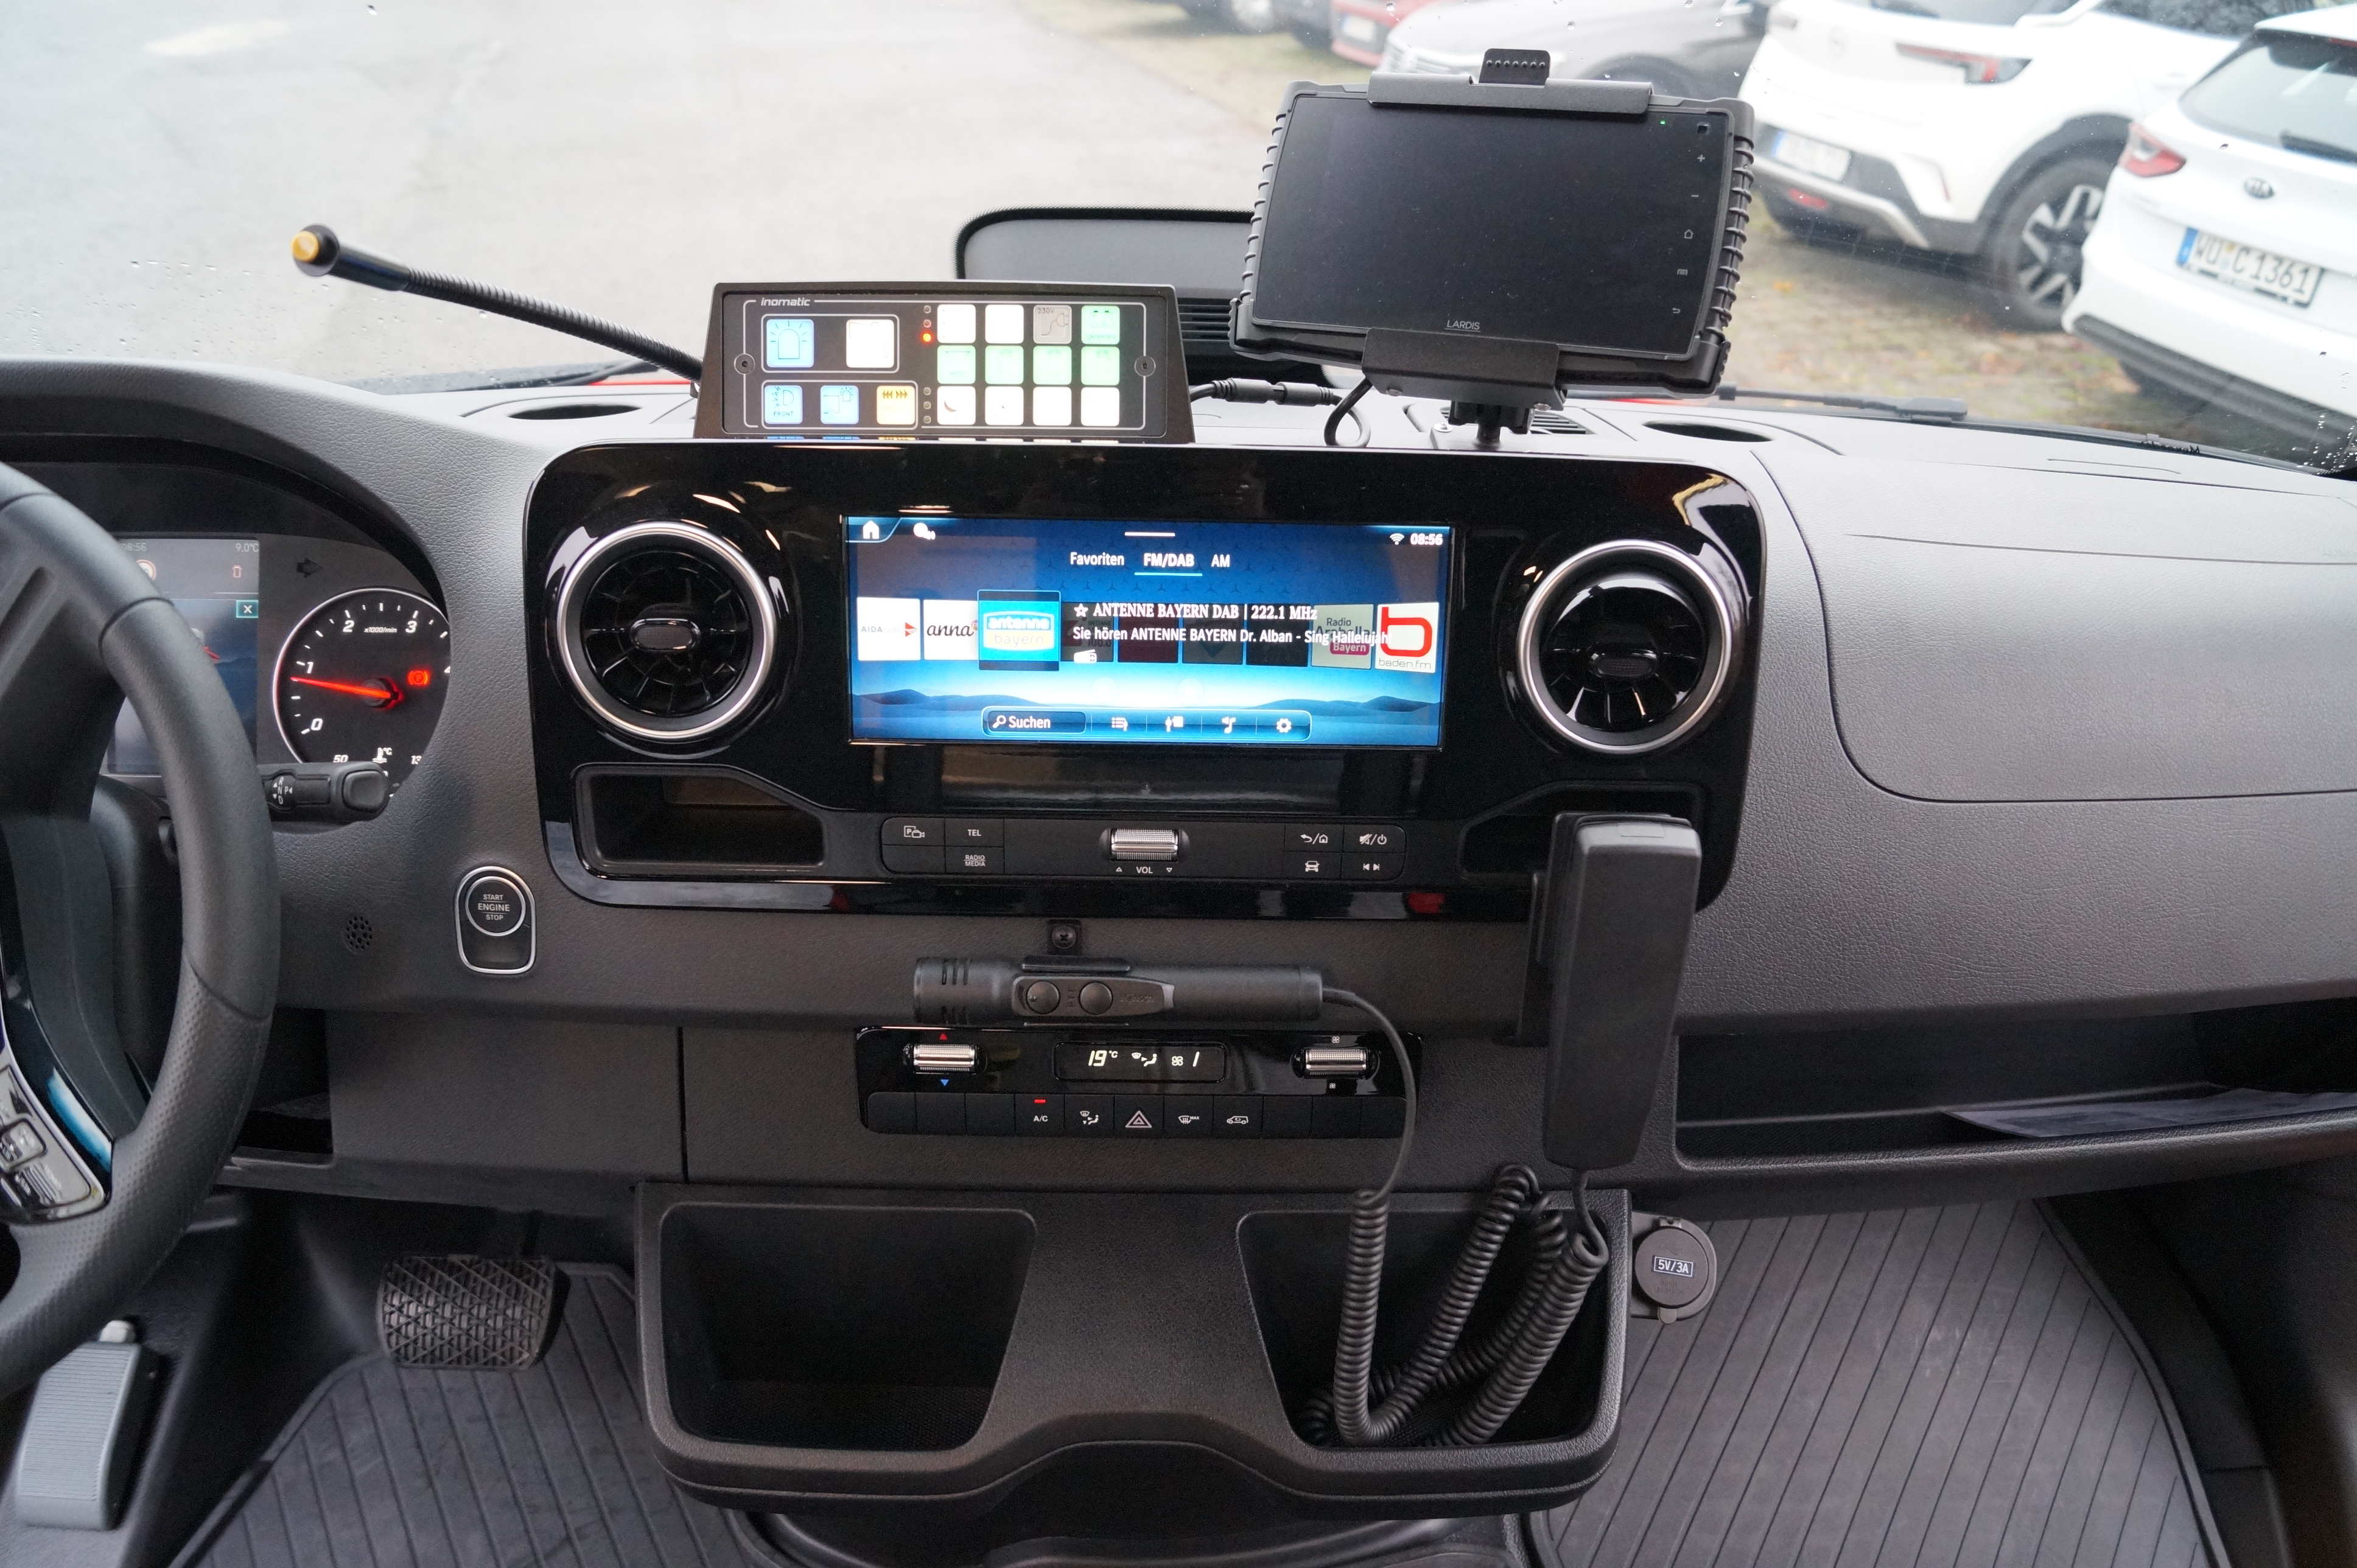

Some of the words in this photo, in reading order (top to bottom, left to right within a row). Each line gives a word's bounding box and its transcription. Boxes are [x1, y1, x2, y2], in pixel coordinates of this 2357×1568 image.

[761, 297, 811, 306] inomatic
[1446, 320, 1480, 330] LARDIS
[1410, 533, 1443, 545] 08:56
[1070, 551, 1125, 565] Favoriten
[1144, 553, 1194, 567] FM/DAB
[1211, 554, 1230, 567] AM
[1093, 603, 1154, 617] ANTENNE
[1158, 603, 1209, 618] BAYERN
[1213, 604, 1239, 618] DAB
[1251, 605, 1285, 619] 222.1
[1289, 606, 1317, 620] MHz
[343, 620, 354, 632] 2
[405, 621, 417, 633] 3
[988, 615, 1051, 630] antenne
[1326, 618, 1351, 627] Radio
[926, 624, 975, 637] anna
[1073, 626, 1091, 640] Sie
[1094, 626, 1127, 640] hören
[1131, 628, 1186, 641] ANTENNE
[1190, 628, 1236, 642] BAYERN
[1240, 629, 1256, 642] Dr.
[1259, 629, 1292, 643] Alban
[1304, 631, 1329, 646] Sing
[1332, 631, 1392, 647] Hallelujah!
[995, 633, 1043, 647] bayern
[1333, 642, 1367, 653] Bayern
[307, 662, 313, 674] 1
[311, 718, 323, 730] 0
[1009, 715, 1051, 728] Suchen
[279, 776, 284, 786] R
[278, 795, 283, 804] D
[478, 903, 510, 912] ENGINE
[1658, 1259, 1689, 1274] 5V/3A
